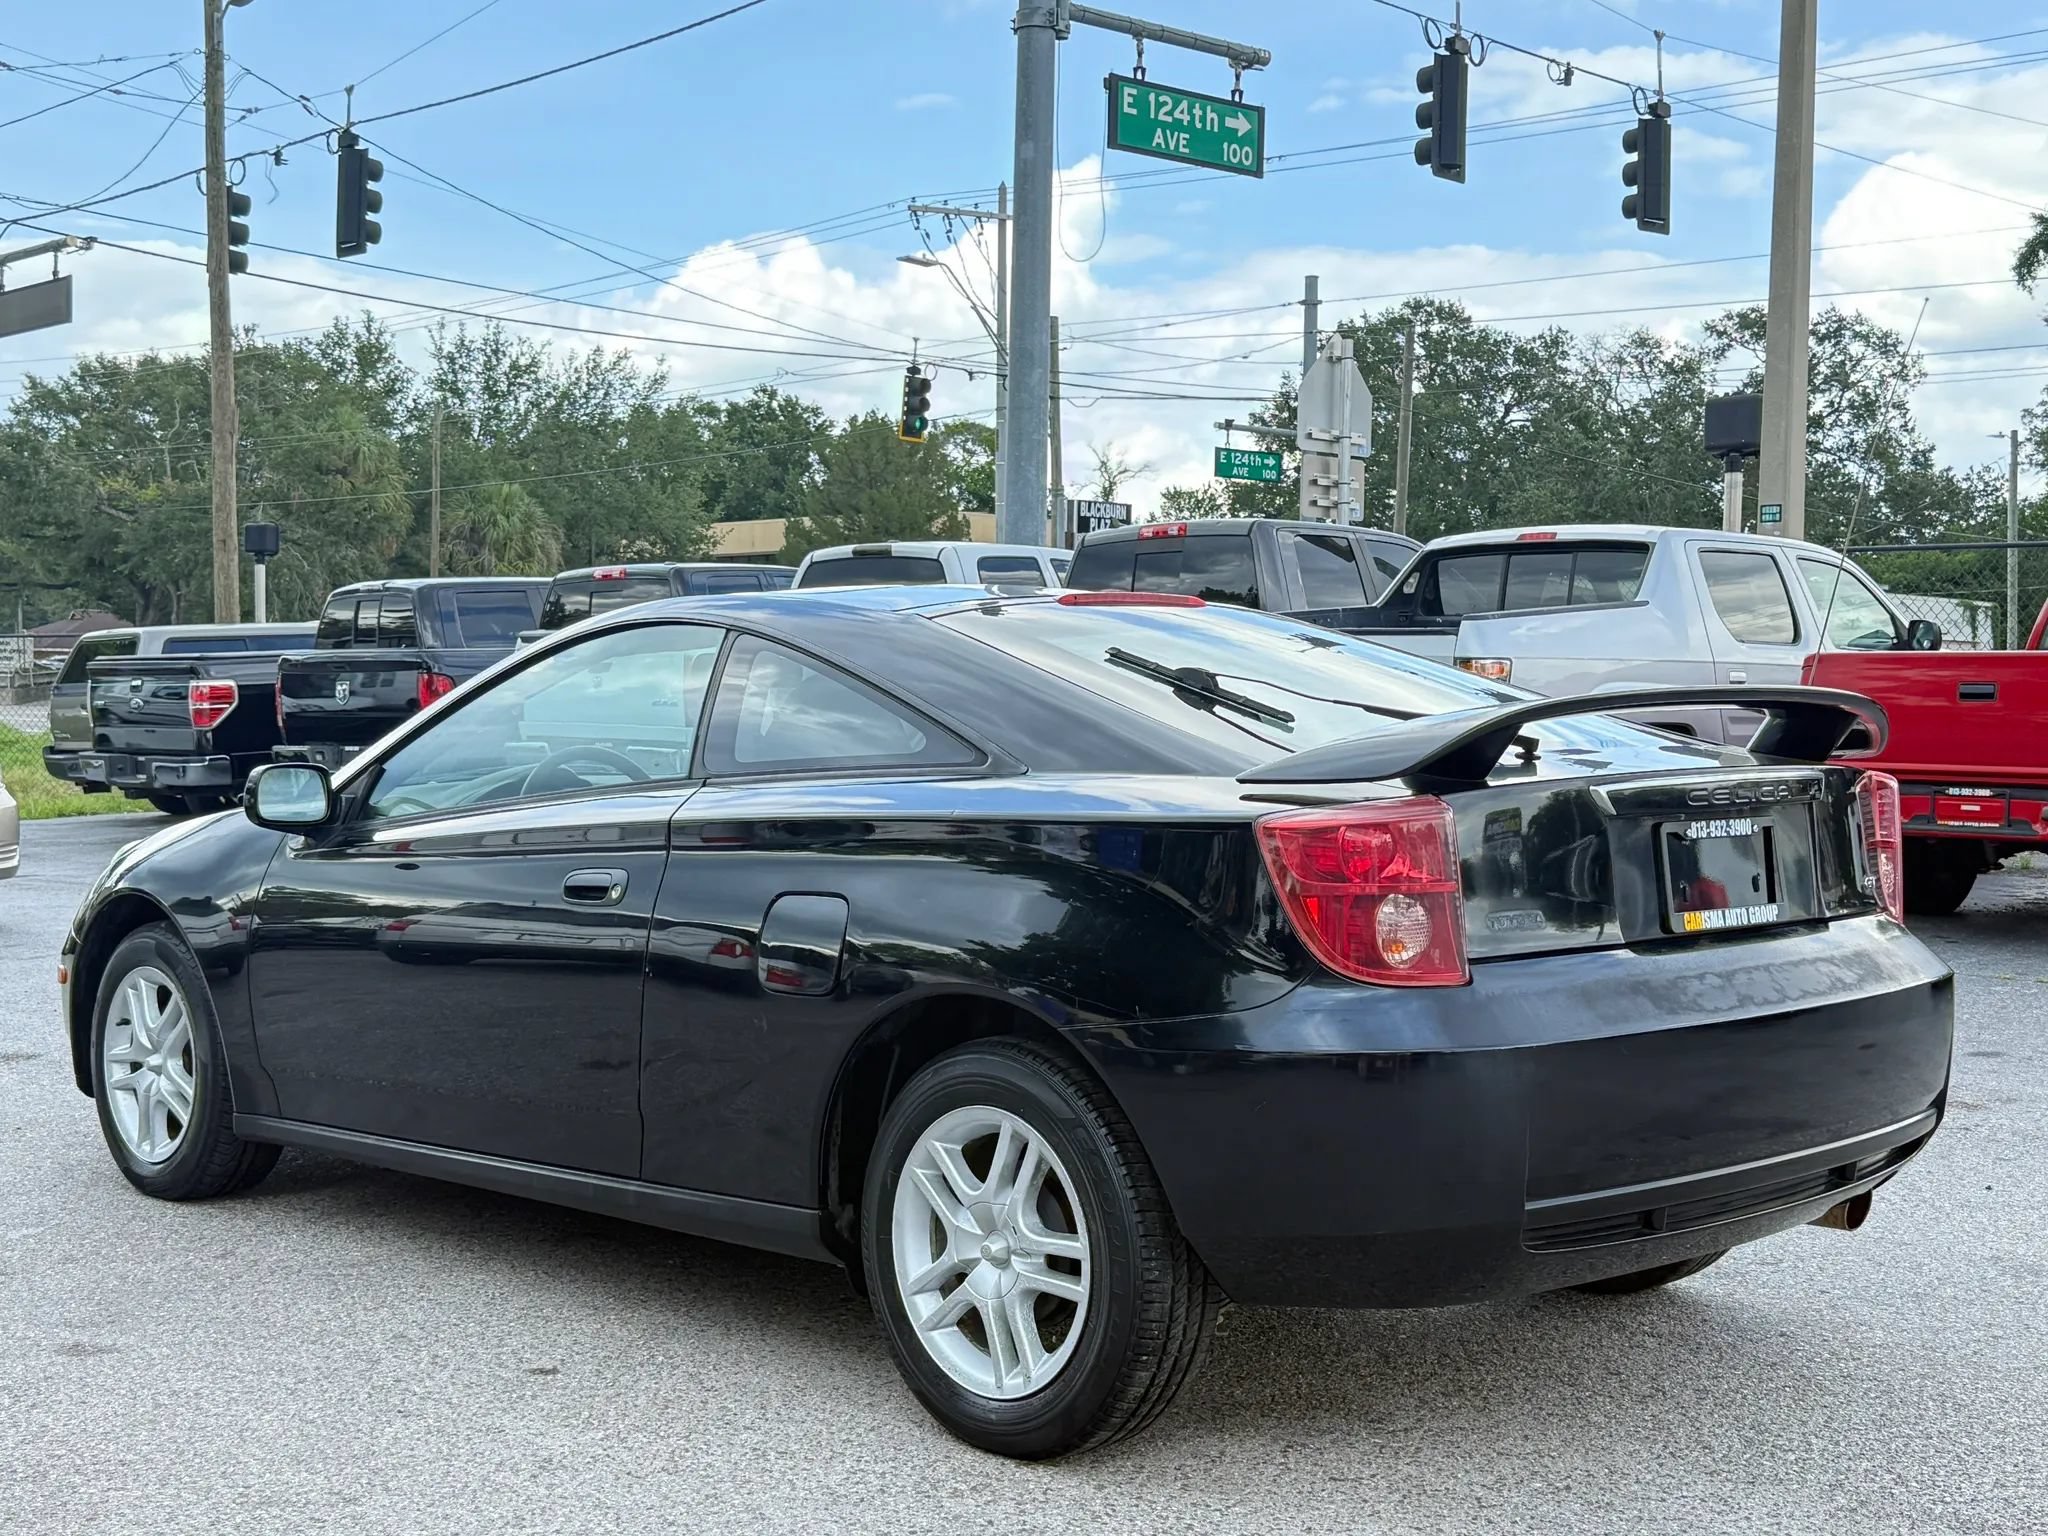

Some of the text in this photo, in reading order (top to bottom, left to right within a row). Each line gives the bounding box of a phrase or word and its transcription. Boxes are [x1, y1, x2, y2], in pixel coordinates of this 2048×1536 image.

[1123, 86, 1219, 133] E 124th
[1152, 128, 1253, 166] AVE 100
[1220, 451, 1262, 467] E 124th
[1232, 466, 1277, 480] AVE 100
[1080, 501, 1127, 520] BLACKBURN
[1090, 517, 1112, 533] PLAZ
[1687, 784, 1792, 806] CELICA
[1691, 818, 1752, 839] 813-932-3900
[1684, 904, 1779, 932] CARISMA AUTO GROUP
